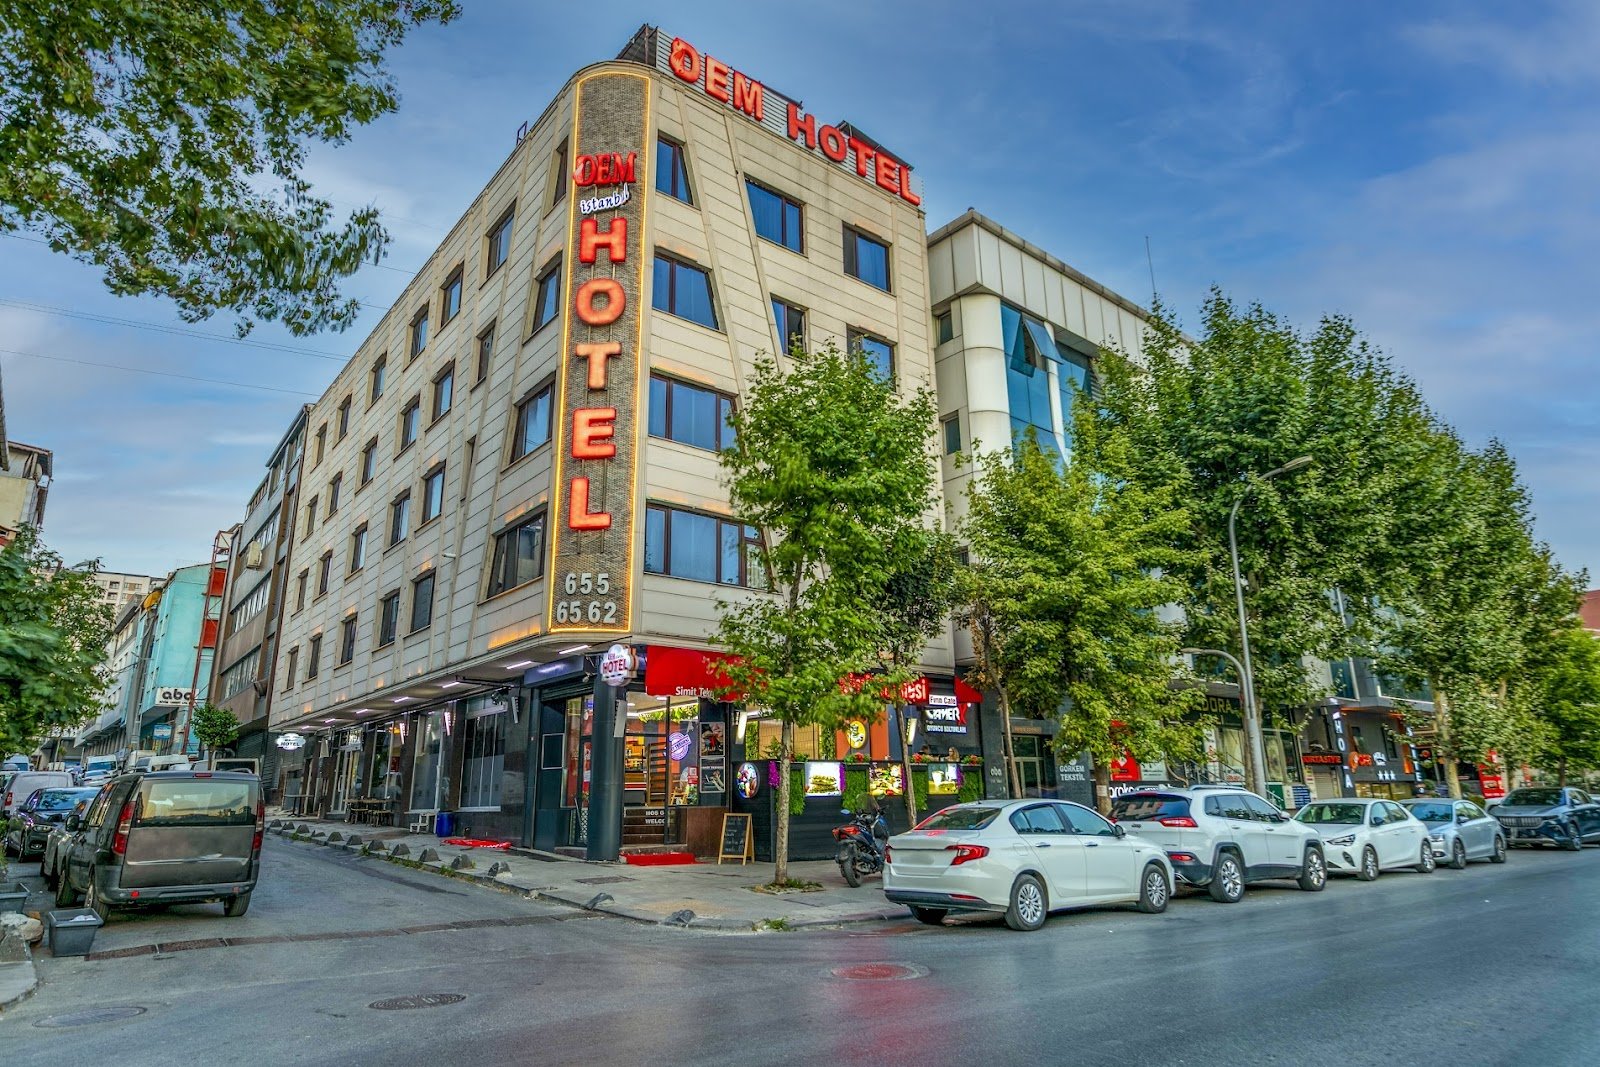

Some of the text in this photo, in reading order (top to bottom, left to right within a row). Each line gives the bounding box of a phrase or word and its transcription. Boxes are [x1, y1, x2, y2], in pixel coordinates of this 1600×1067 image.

[787, 102, 921, 206] HOTEL
[569, 217, 626, 531] HOTEL
[565, 573, 609, 595] 655
[602, 658, 628, 674] HOTEL
[675, 686, 697, 696] Simit
